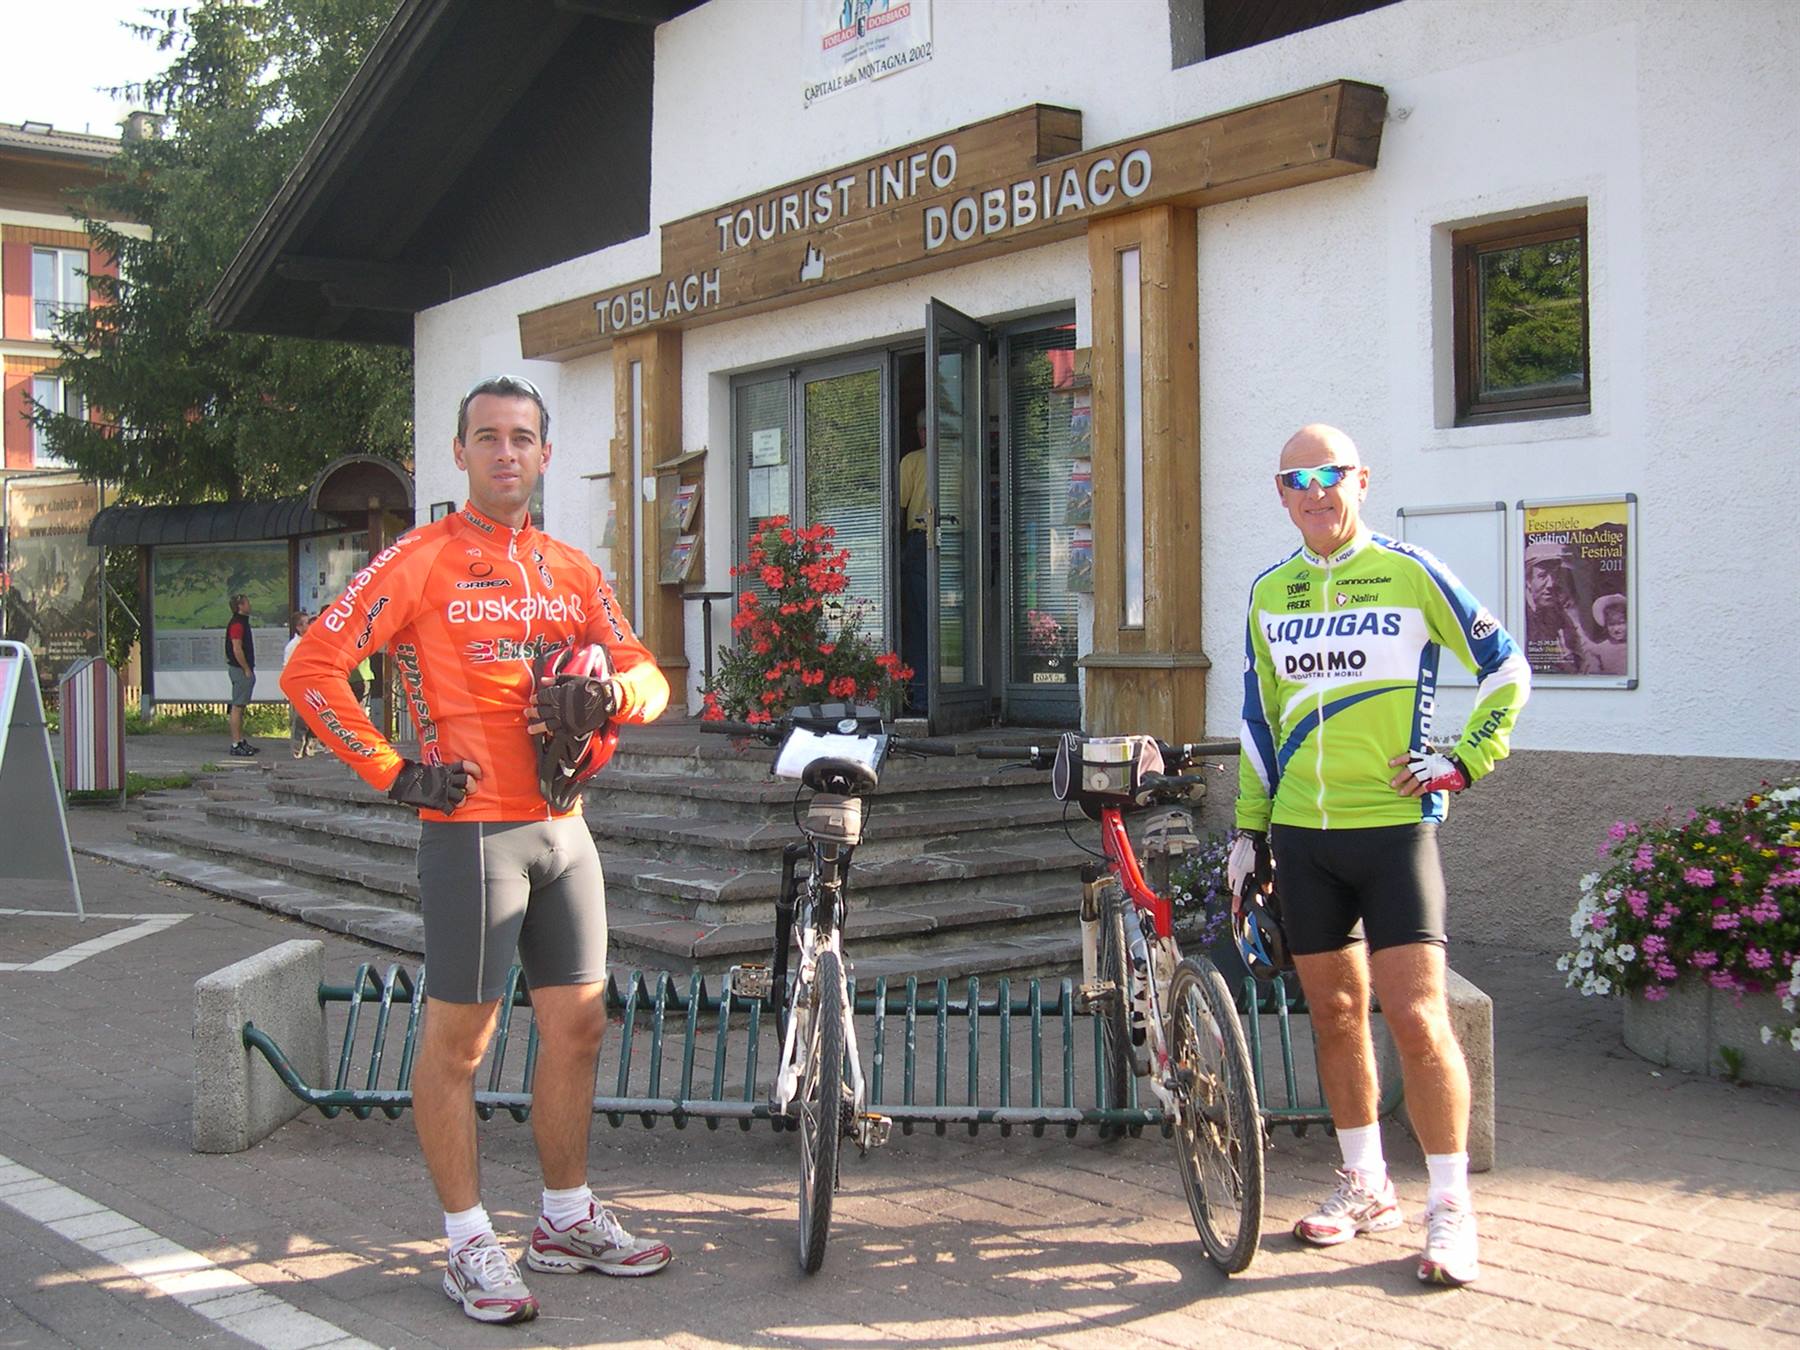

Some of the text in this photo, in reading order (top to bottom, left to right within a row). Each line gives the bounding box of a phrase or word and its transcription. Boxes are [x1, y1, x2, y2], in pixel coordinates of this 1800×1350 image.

[823, 26, 857, 49] TOBLACH
[867, 5, 910, 29] DOBBIACO
[804, 77, 843, 101] CAPITALE
[843, 73, 858, 87] della
[858, 52, 907, 80] MONTAGNA
[908, 41, 932, 62] 2002
[714, 143, 957, 252] TOURIST INFO
[922, 148, 1152, 251] DOBBIACO
[593, 267, 721, 334] TOBLACH
[1528, 517, 1580, 532] Festspiele
[1581, 545, 1623, 559] Festival
[1600, 560, 1623, 572] 2011
[456, 579, 513, 589] ORBEA
[1336, 576, 1392, 586] cannondale
[448, 592, 568, 623] euskaltel
[1350, 593, 1379, 604] Nalini
[1266, 612, 1402, 646] LIQUIGAS
[1285, 650, 1367, 674] DOIMO
